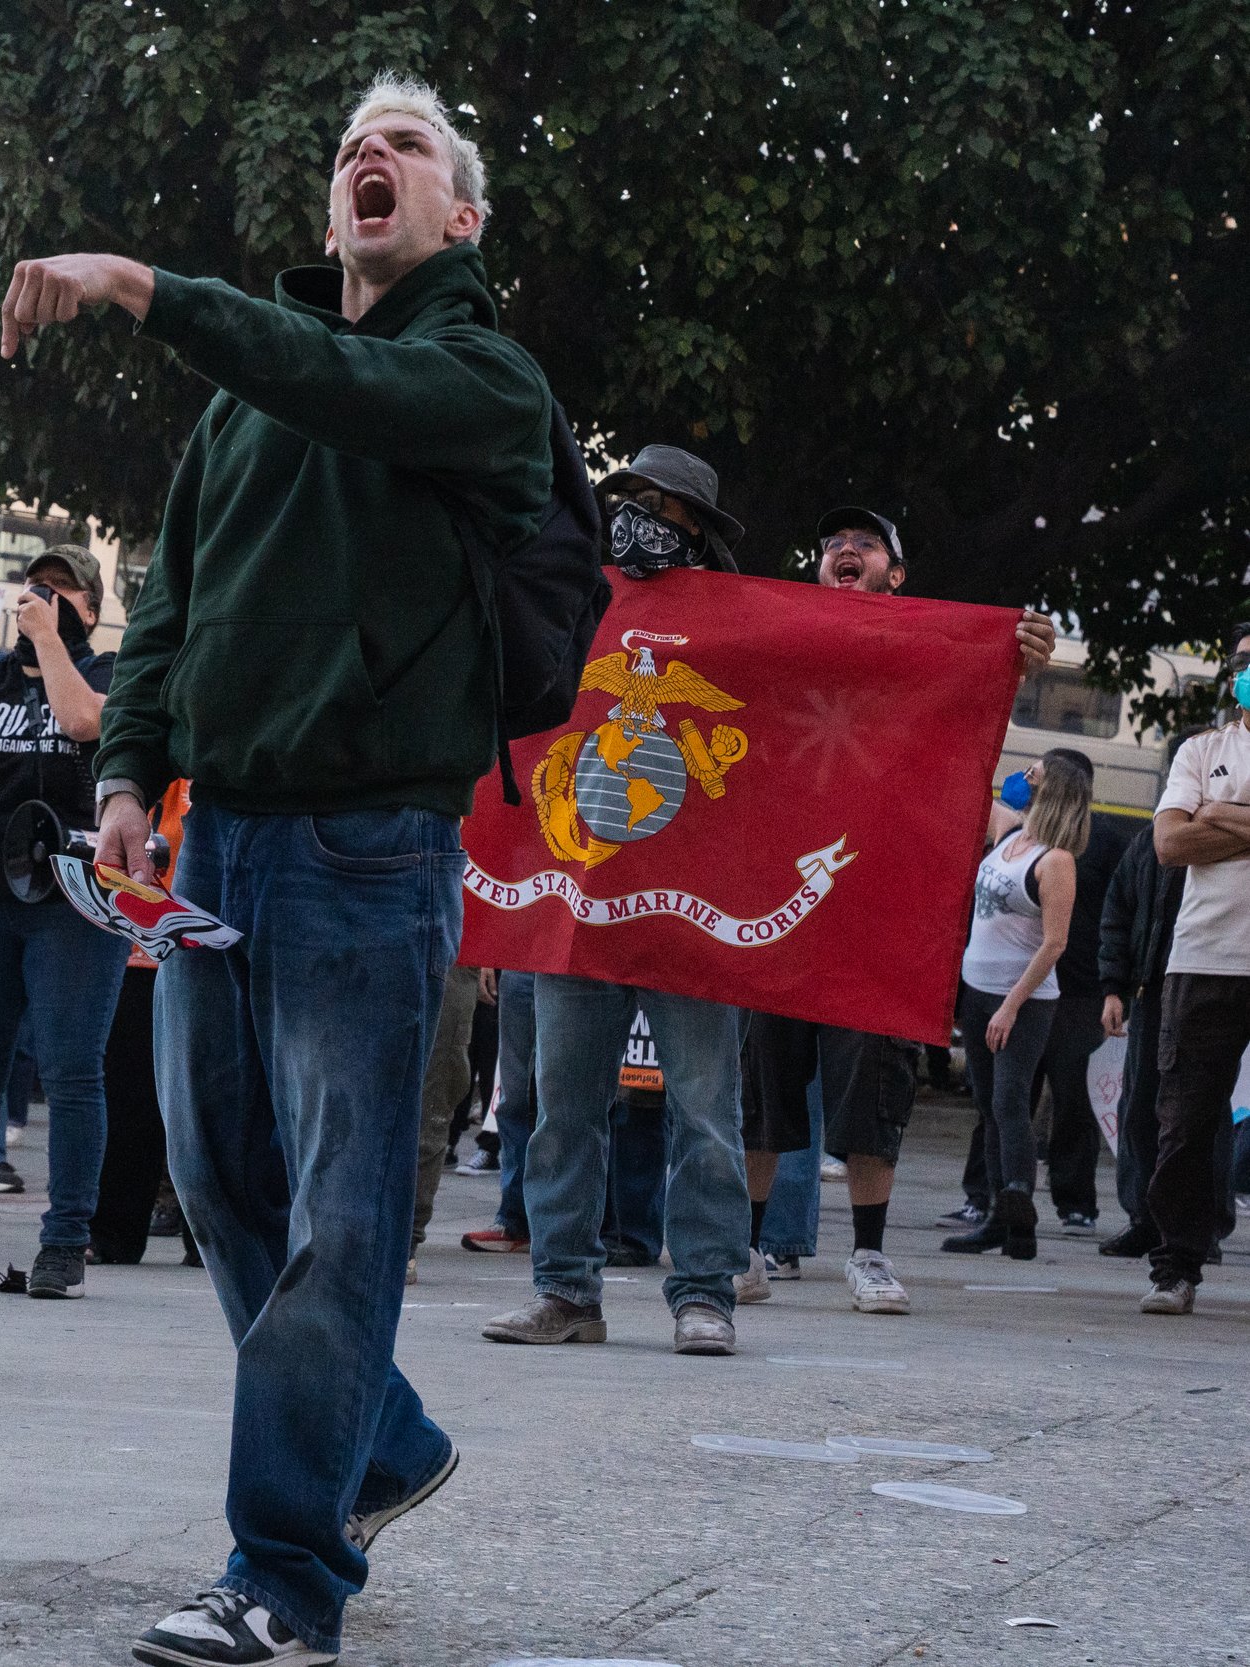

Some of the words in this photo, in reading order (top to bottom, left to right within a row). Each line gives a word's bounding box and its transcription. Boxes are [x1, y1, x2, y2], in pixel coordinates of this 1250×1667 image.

[633, 630, 656, 640] SEMPER
[462, 862, 520, 906] ITED
[532, 873, 594, 919] STATES
[607, 892, 722, 933] MARINE
[736, 884, 820, 944] CORPS
[621, 1038, 659, 1067] TR
